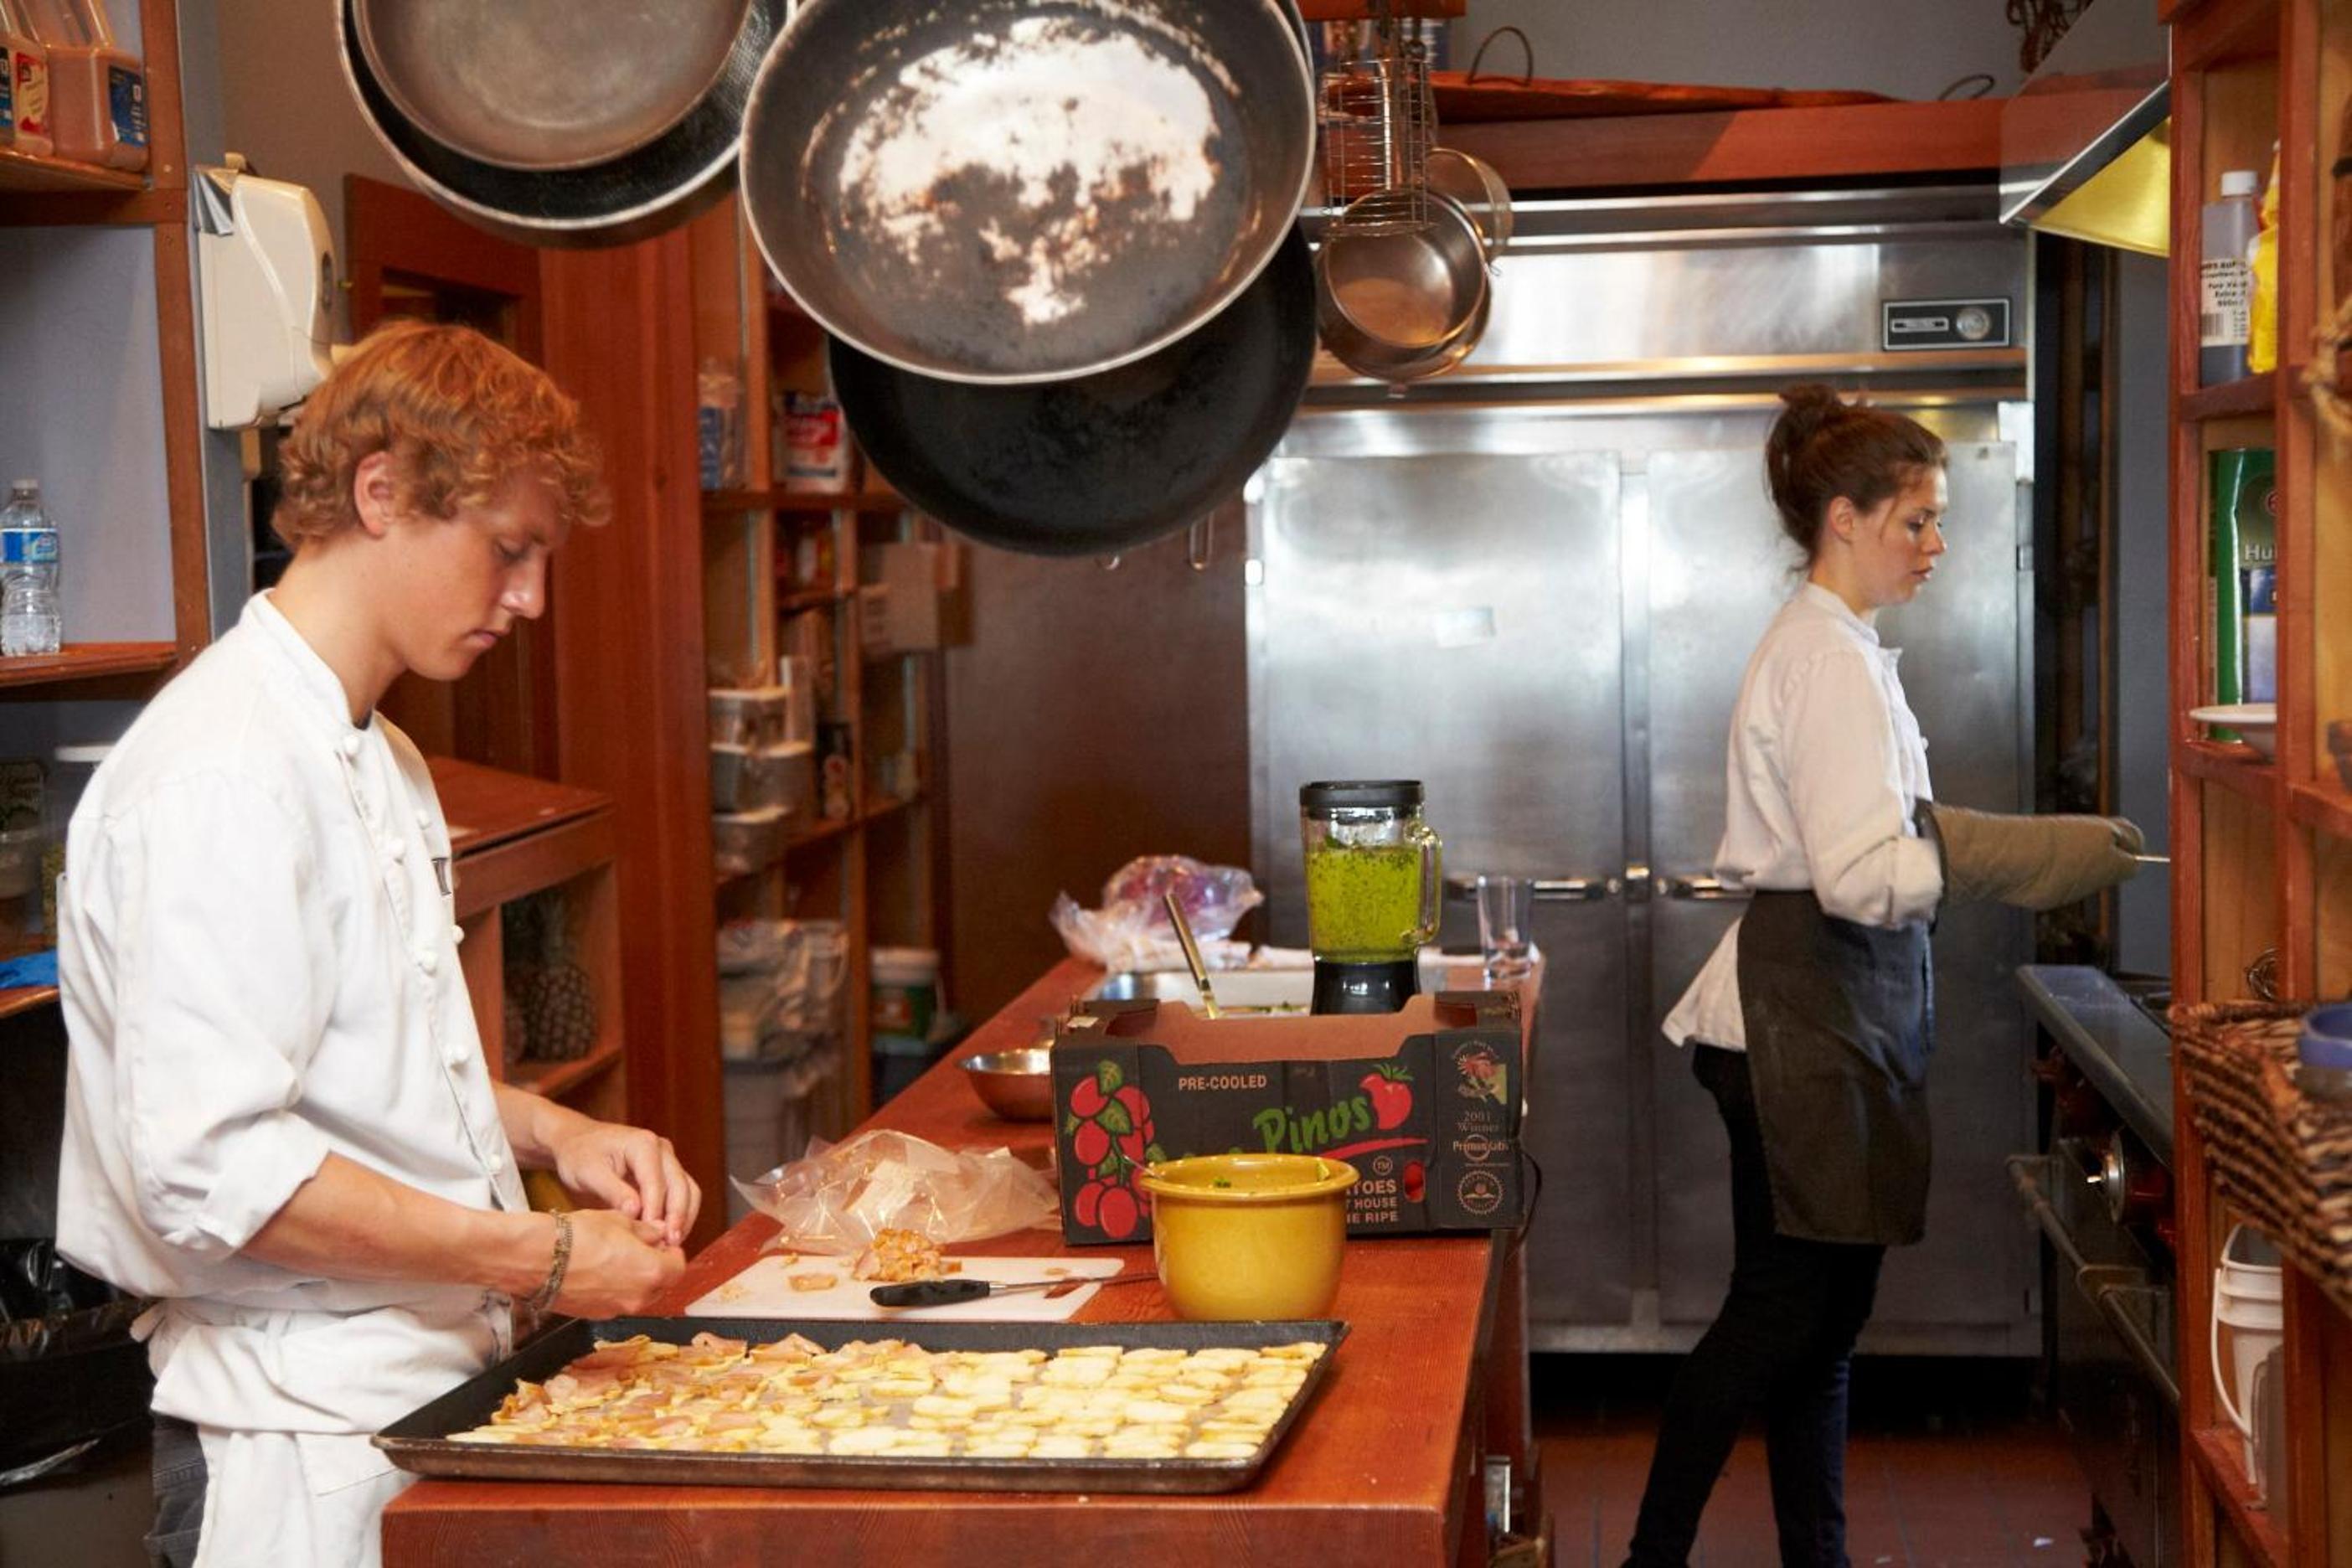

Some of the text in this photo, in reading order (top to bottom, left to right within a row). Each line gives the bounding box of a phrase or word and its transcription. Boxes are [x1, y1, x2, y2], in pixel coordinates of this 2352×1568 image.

[1178, 1075, 1267, 1091] PRE-COOLED
[1253, 1096, 1370, 1154] Pinos
[1346, 1179, 1397, 1196] TOES
[1354, 1196, 1398, 1210] HOUSE
[1365, 1210, 1399, 1224] RIPE
